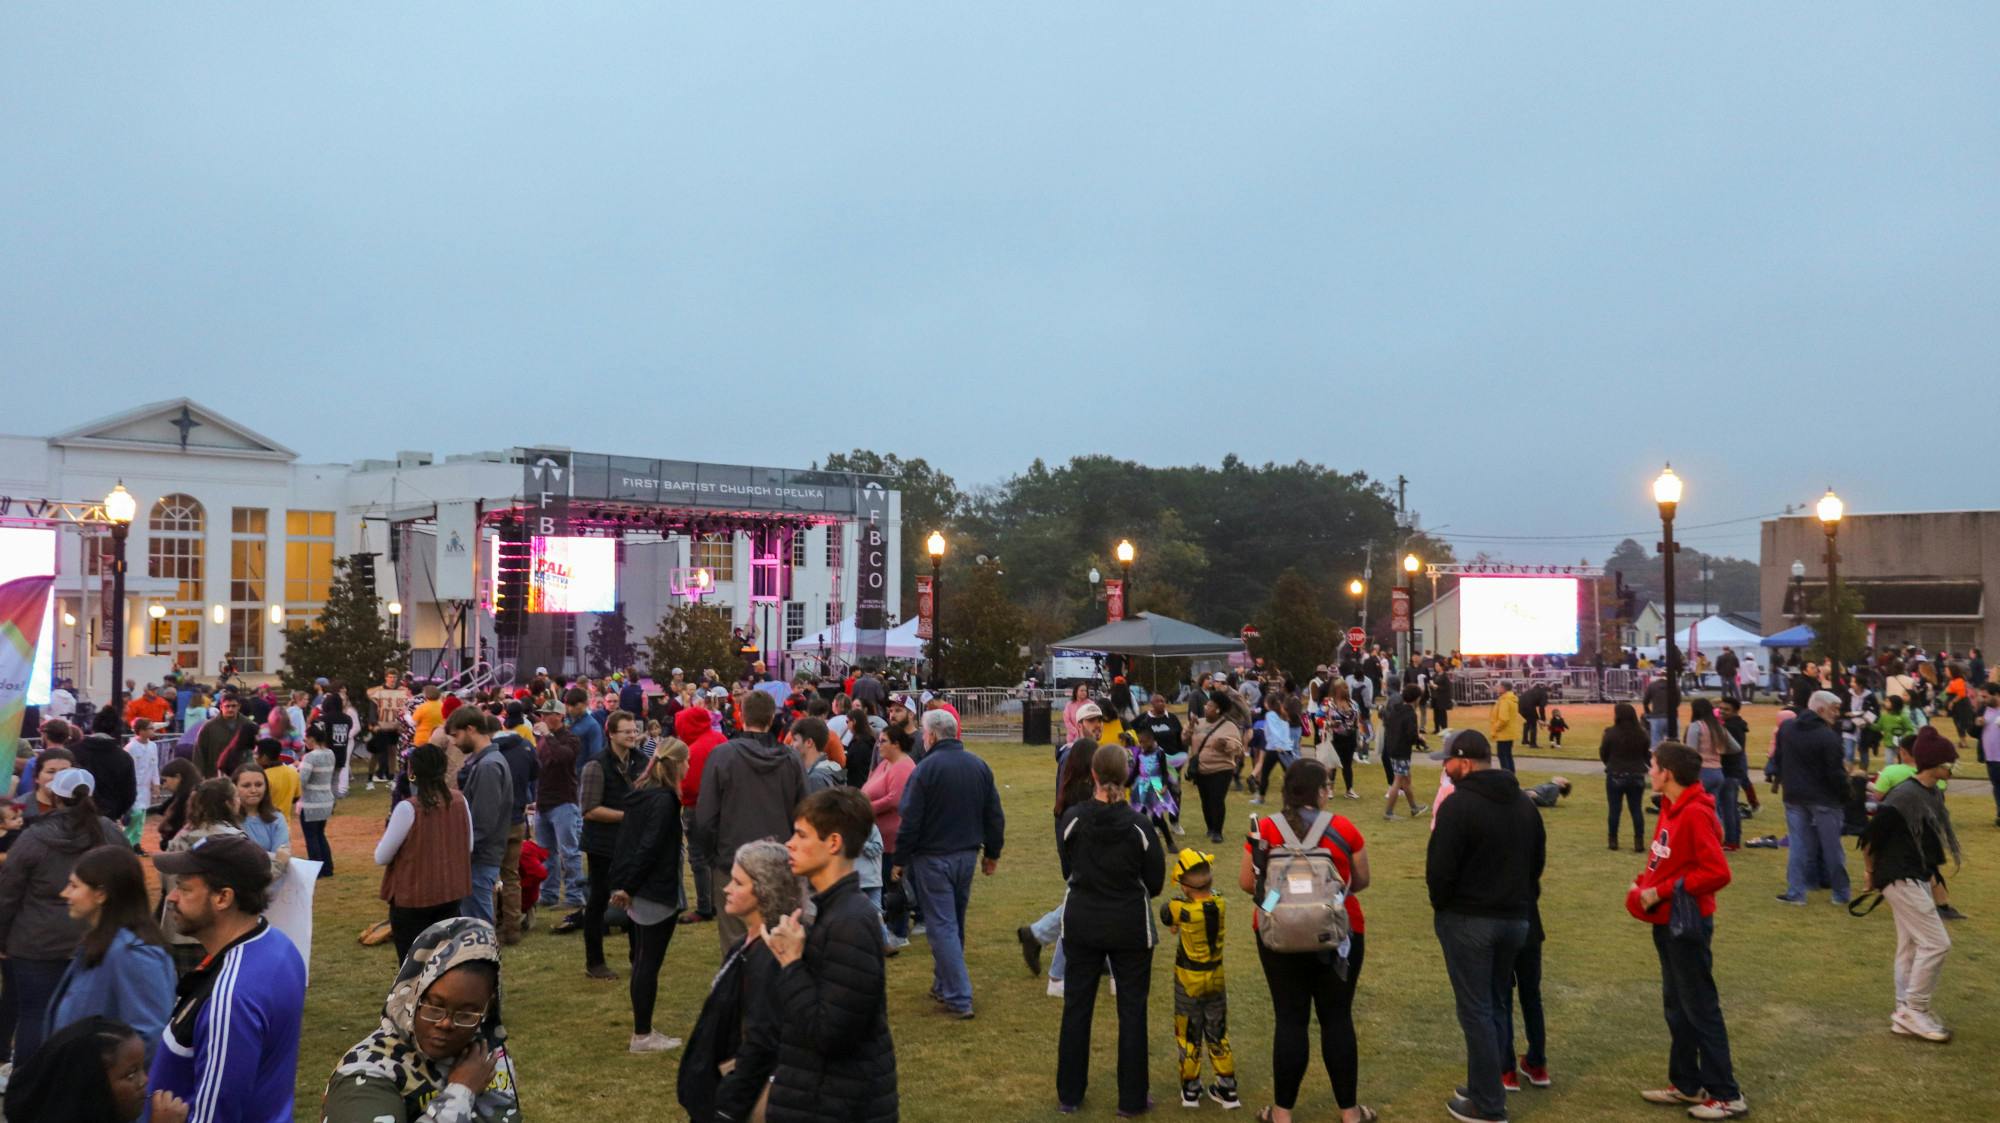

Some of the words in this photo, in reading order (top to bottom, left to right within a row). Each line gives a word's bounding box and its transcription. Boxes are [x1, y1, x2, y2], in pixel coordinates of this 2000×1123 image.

[622, 477, 660, 489] FIRST
[664, 481, 716, 492] BAPTIST
[720, 484, 771, 496] CHURCH
[775, 486, 824, 499] OPELIKA
[1348, 632, 1368, 642] STOP
